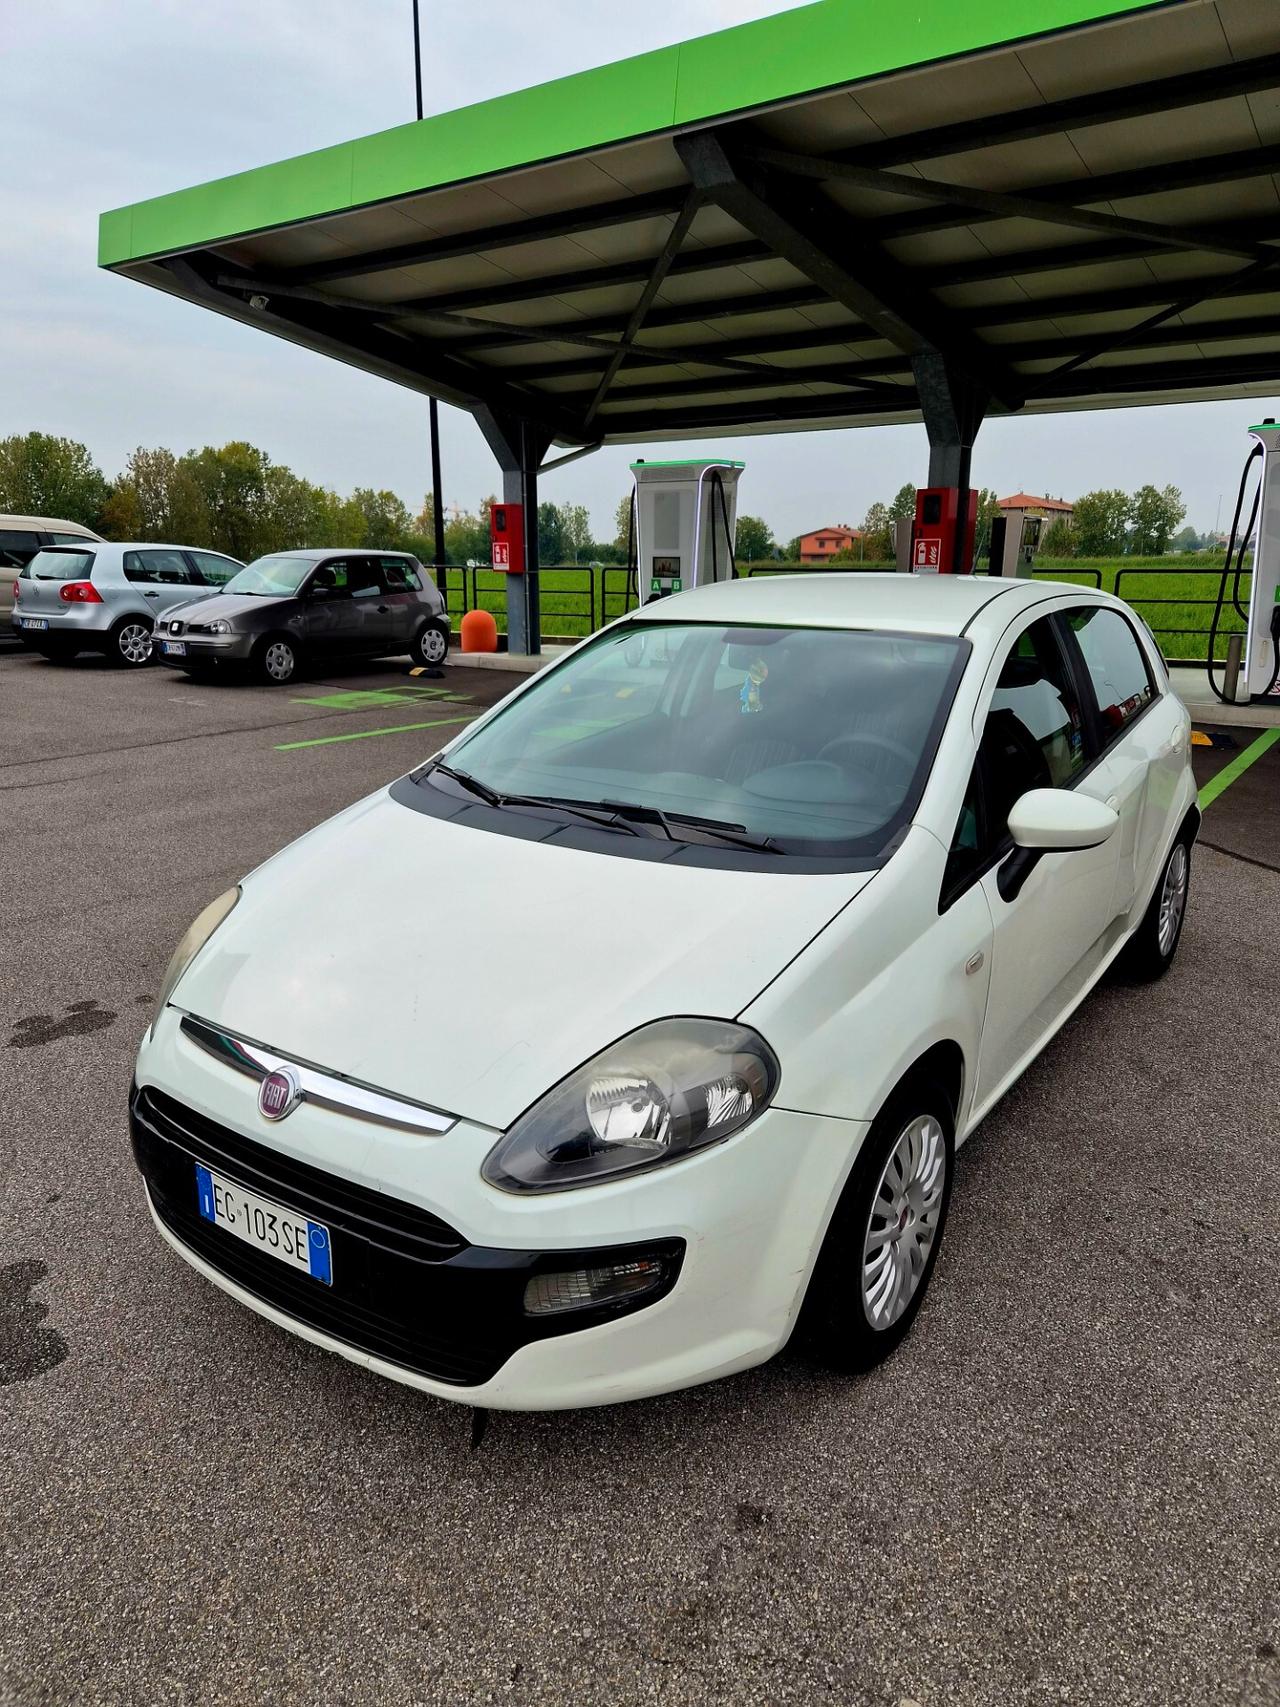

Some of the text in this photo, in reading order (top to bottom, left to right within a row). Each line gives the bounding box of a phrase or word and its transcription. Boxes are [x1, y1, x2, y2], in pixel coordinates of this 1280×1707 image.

[652, 581, 660, 590] A
[673, 581, 680, 590] B
[263, 1082, 287, 1109] FIAT
[213, 1183, 309, 1263] EG 103SE
